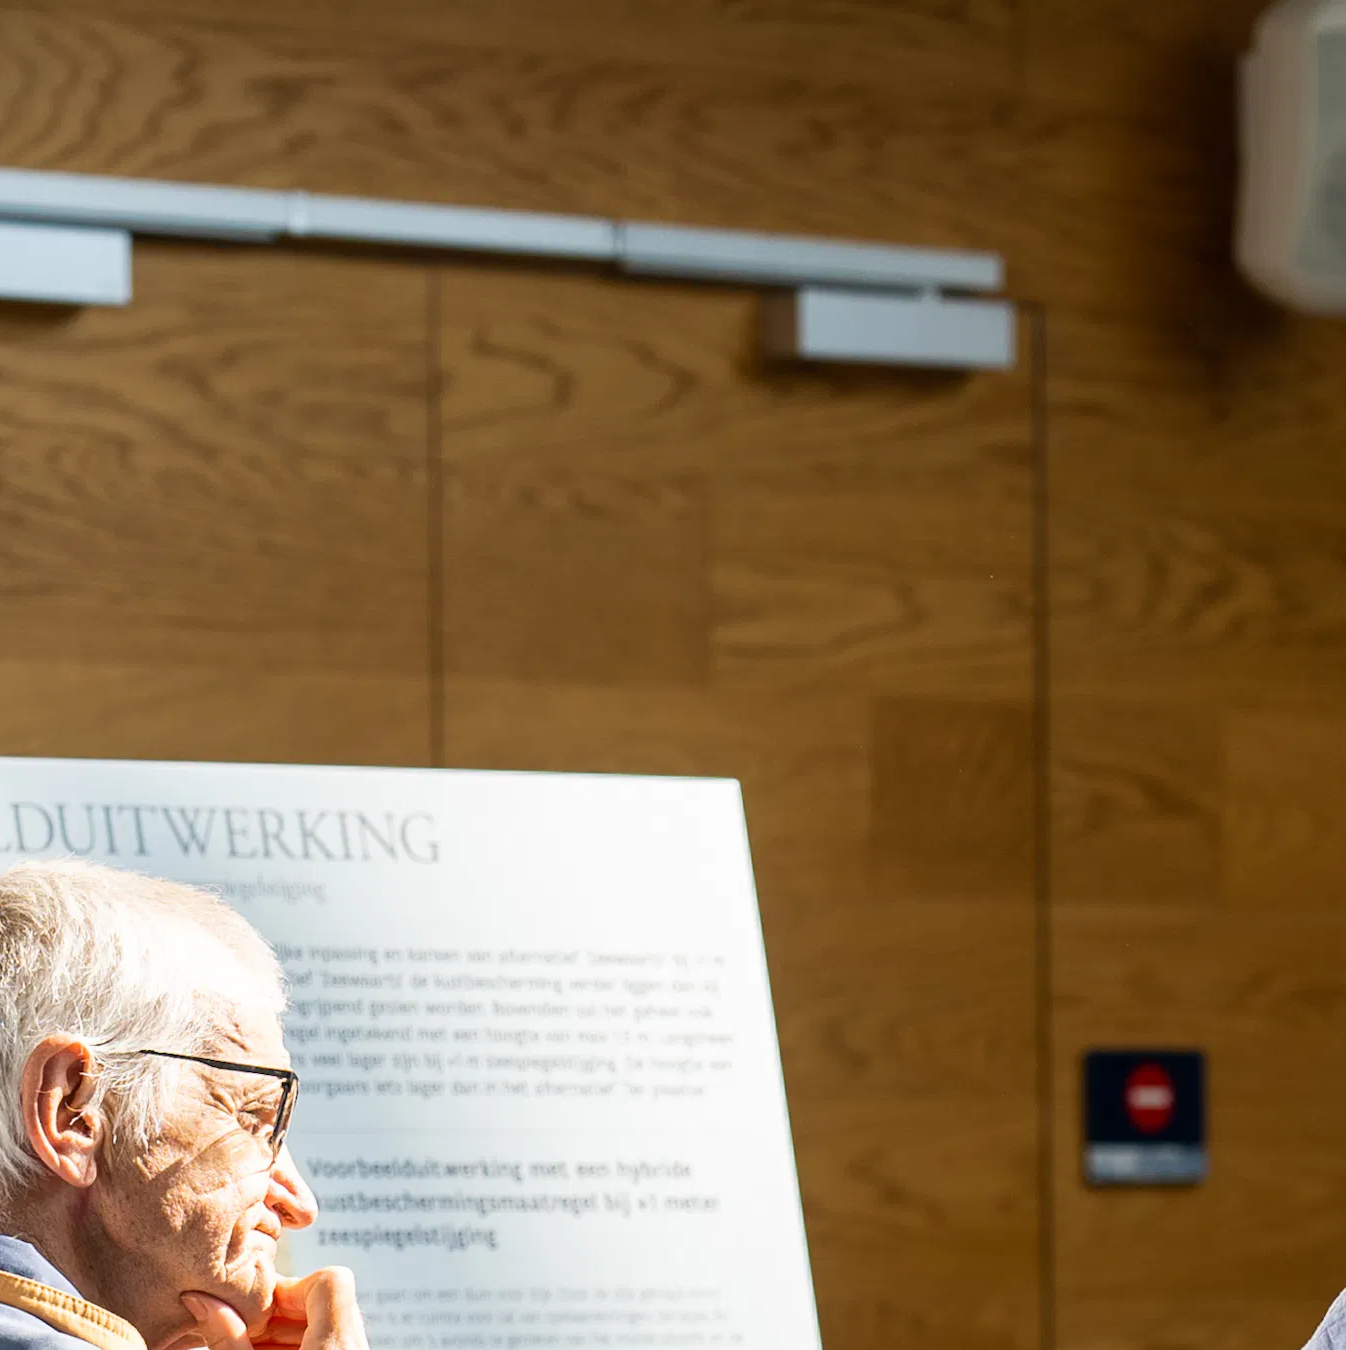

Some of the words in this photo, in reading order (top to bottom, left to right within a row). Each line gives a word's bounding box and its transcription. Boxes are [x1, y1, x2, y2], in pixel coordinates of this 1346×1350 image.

[306, 1157, 523, 1184] Voorbeelduitwerking
[529, 1159, 568, 1179] met
[575, 1161, 610, 1179] een
[616, 1159, 692, 1184] hybride
[604, 1191, 632, 1219] bij
[663, 1194, 721, 1213] meter
[318, 1224, 499, 1252] zeespiegelstijging
